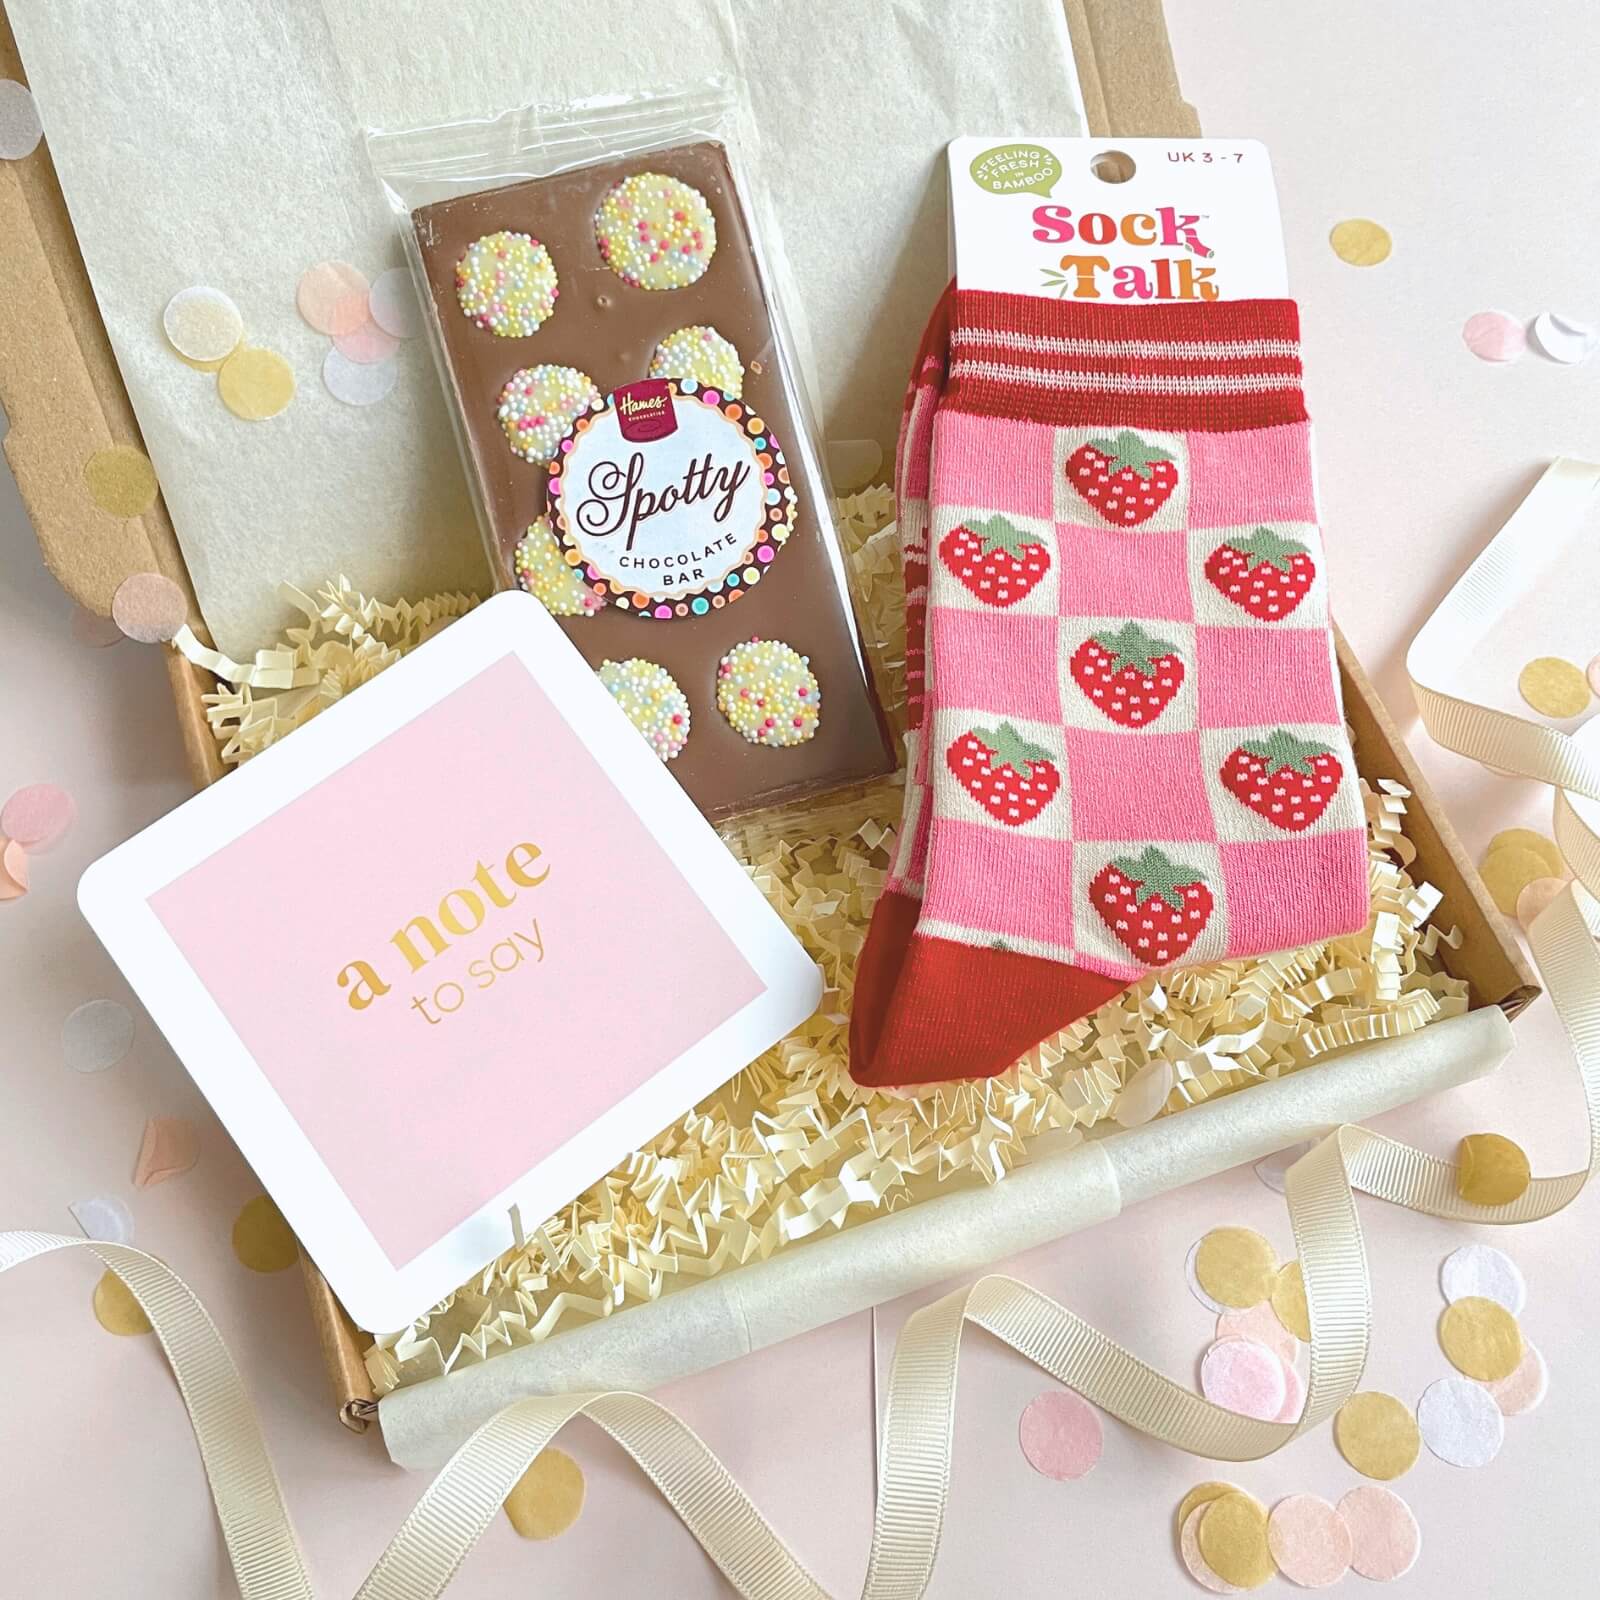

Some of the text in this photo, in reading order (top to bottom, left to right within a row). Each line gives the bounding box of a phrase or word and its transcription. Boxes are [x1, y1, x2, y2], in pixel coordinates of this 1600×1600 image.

[980, 150, 1040, 172] FEELING
[991, 160, 1040, 178] FRESH
[1167, 152, 1196, 163] UK
[1202, 152, 1213, 163] 3
[1233, 152, 1244, 163] 7
[992, 168, 1053, 190] BAMBOO
[1032, 205, 1214, 258] Sock
[1060, 255, 1219, 300] Talk
[576, 452, 750, 551] Spotty
[619, 533, 737, 569] CHOCOLATE
[663, 568, 705, 586] BAR
[337, 842, 551, 1010] a note
[411, 918, 545, 1025] to say
